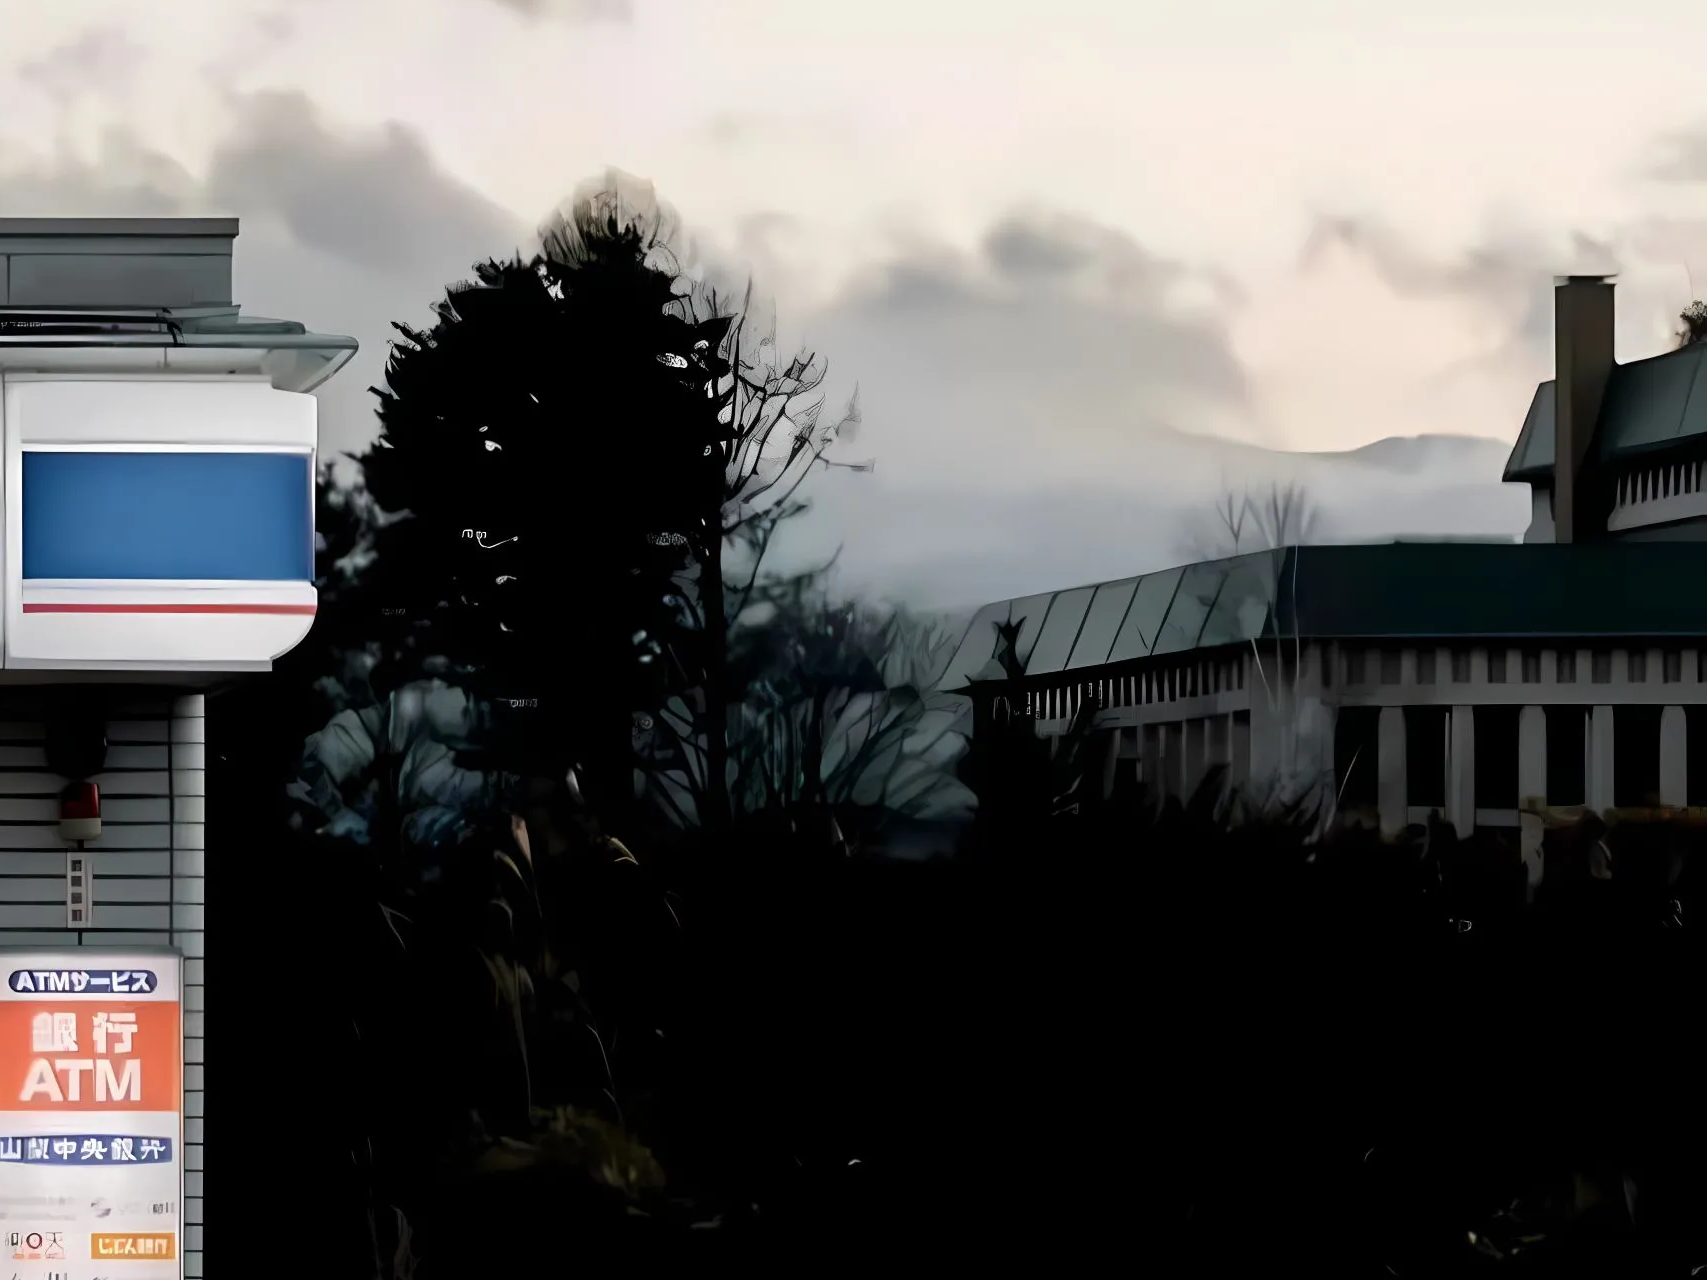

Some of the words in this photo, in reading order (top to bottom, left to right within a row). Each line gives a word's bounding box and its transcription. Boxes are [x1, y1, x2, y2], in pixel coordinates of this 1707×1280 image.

[16, 970, 152, 993] ATMサービス
[19, 1058, 141, 1102] ATM
